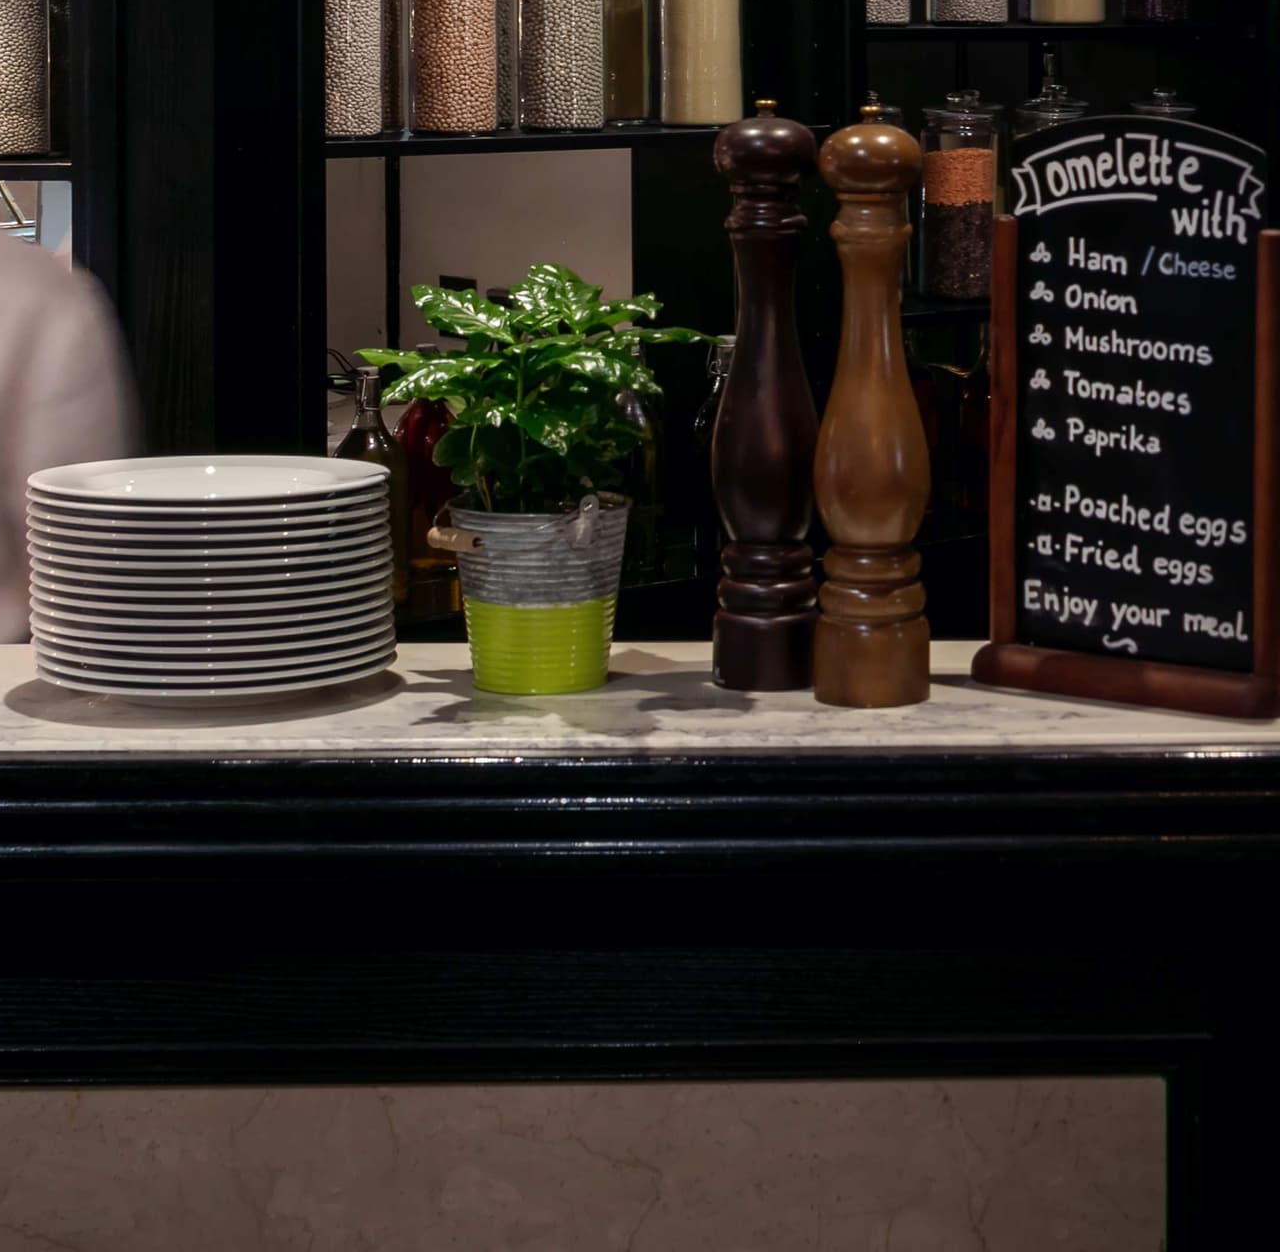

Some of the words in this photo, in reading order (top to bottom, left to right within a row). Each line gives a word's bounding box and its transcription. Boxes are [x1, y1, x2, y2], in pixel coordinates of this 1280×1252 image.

[1045, 136, 1204, 197] omelette
[1170, 190, 1248, 245] with
[1068, 236, 1127, 276] Ham
[1065, 283, 1138, 315] Onion
[1064, 326, 1214, 366] Mushrooms
[1063, 370, 1192, 415] Tomatoes
[1066, 417, 1161, 457] Paprika
[1064, 484, 1171, 535] Poached
[1178, 512, 1247, 547] eggs
[1064, 533, 1142, 574] Fried
[1152, 556, 1215, 585] eggs
[1023, 579, 1098, 626] Enjoy
[1110, 602, 1171, 631] your
[1183, 610, 1248, 641] meal
